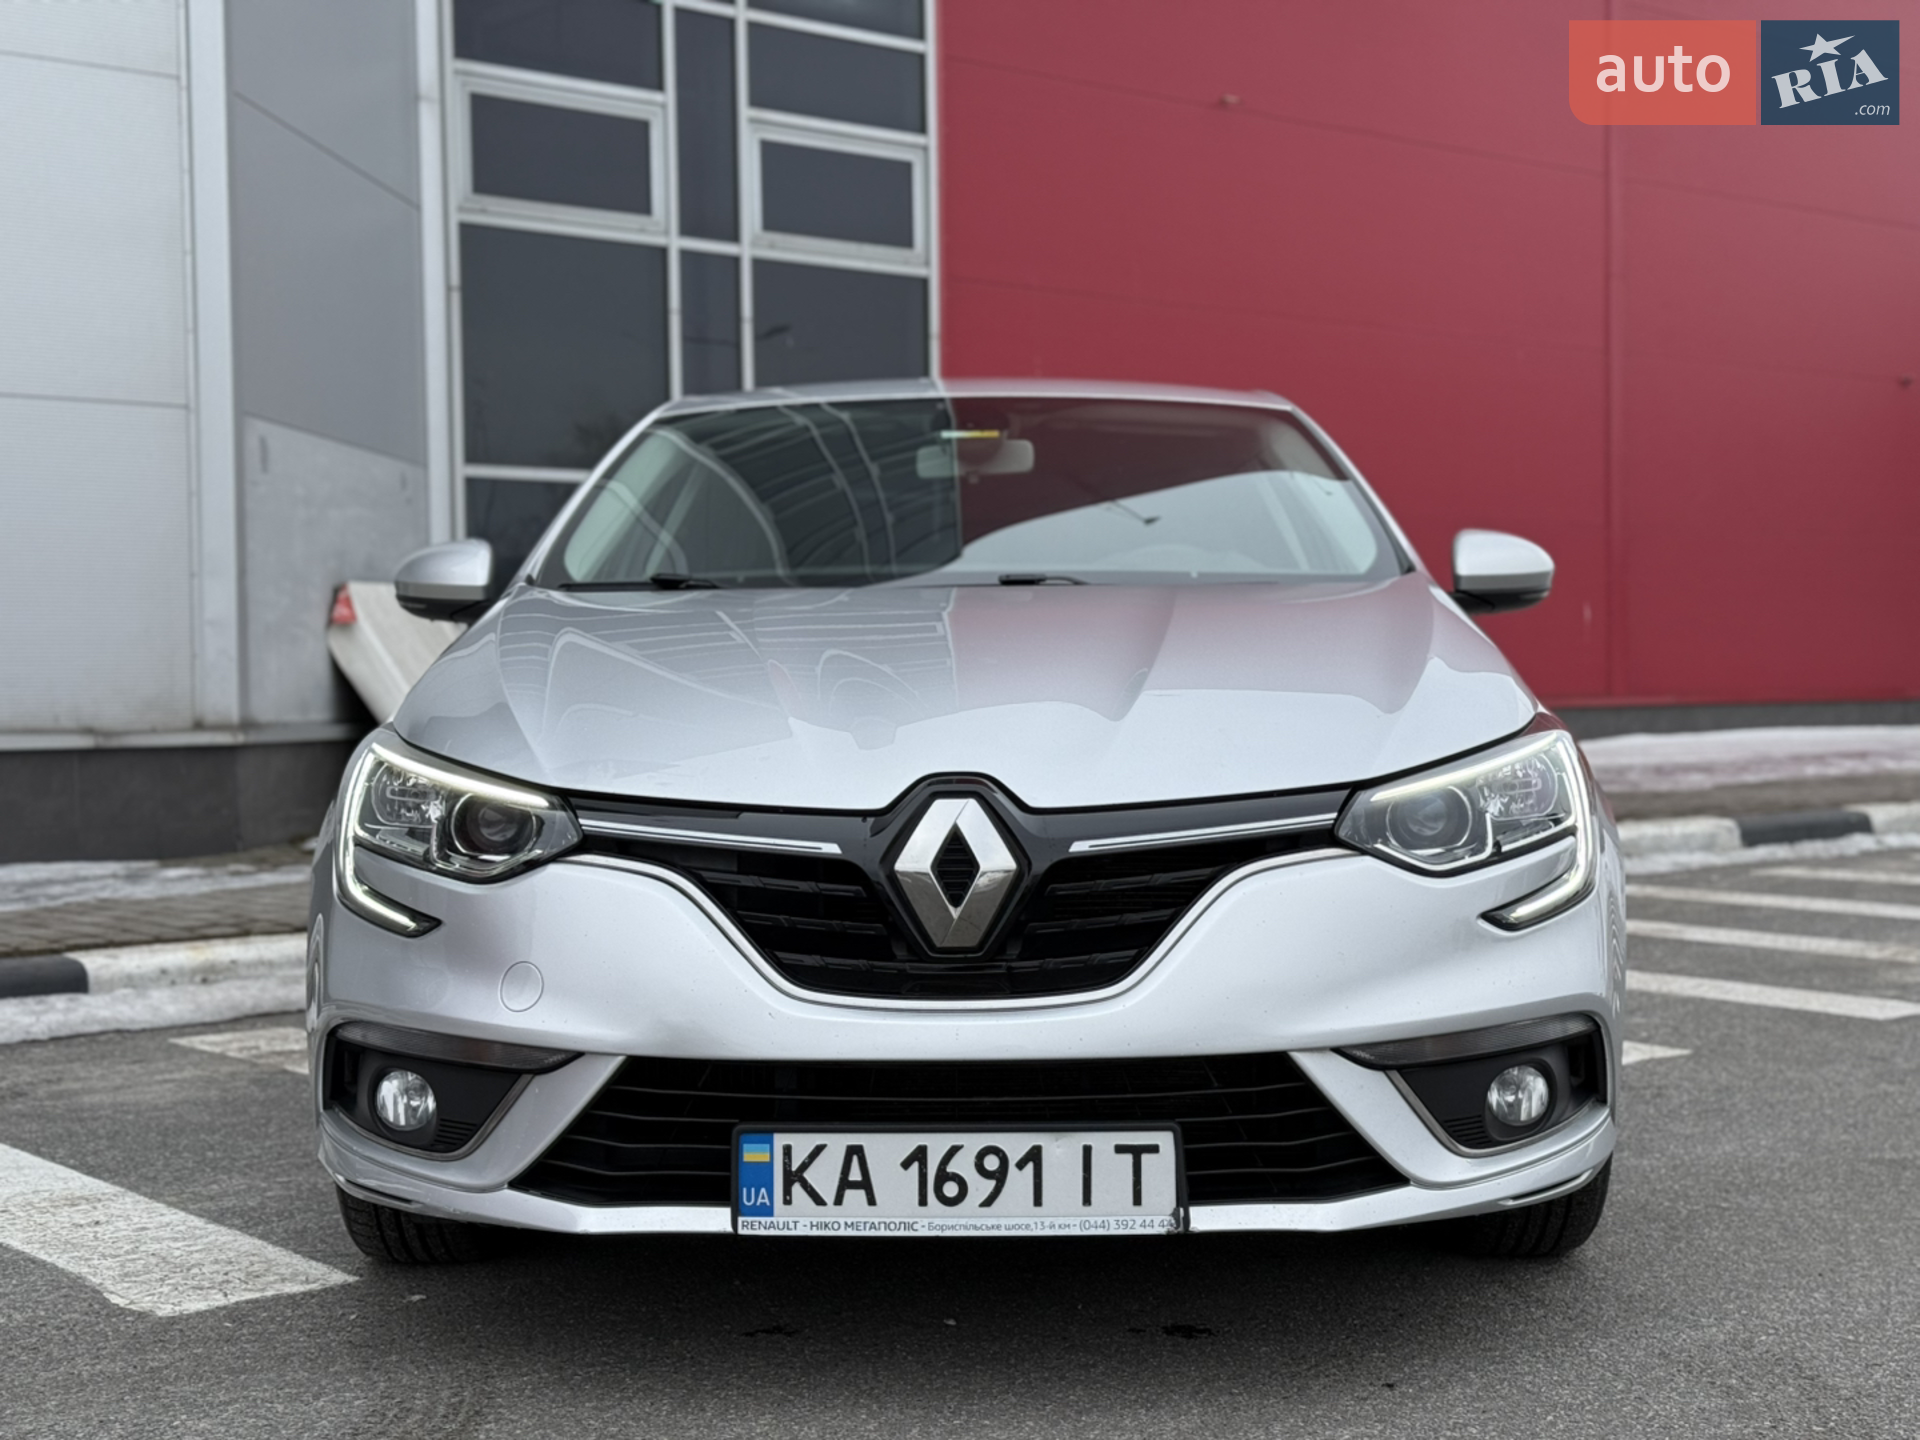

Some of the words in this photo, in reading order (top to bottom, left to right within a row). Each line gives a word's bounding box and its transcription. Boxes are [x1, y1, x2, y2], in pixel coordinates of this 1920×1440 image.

[781, 1143, 877, 1207] KA
[899, 1143, 1043, 1208] 1691
[1081, 1143, 1160, 1207] IT
[742, 1187, 770, 1206] UA
[741, 1220, 800, 1231] RENAULT
[810, 1220, 841, 1231] НІКО
[844, 1220, 919, 1232] МЕГАПОЛІС
[928, 1219, 1002, 1233] Бориспільське
[1079, 1219, 1111, 1232] (044)
[1113, 1219, 1136, 1230] 392
[1139, 1219, 1155, 1229] 44
